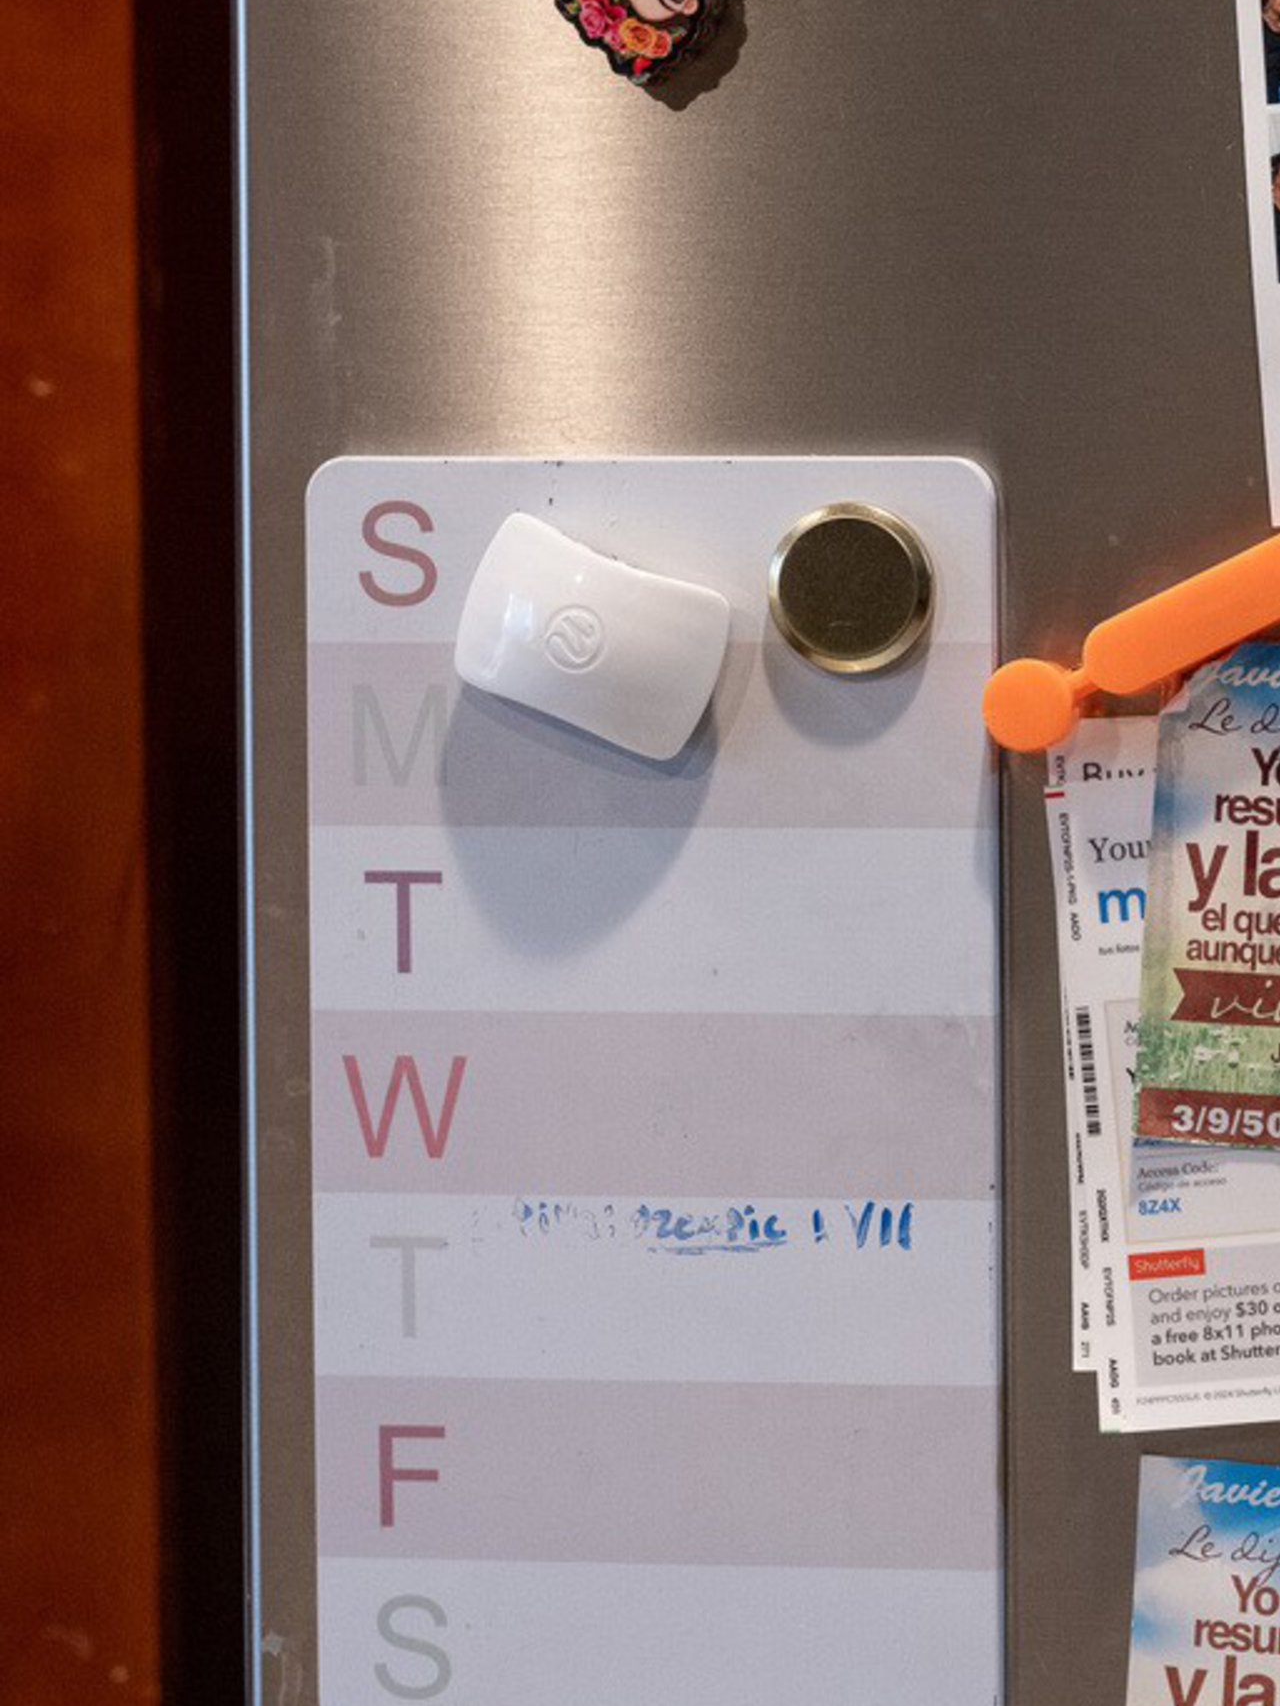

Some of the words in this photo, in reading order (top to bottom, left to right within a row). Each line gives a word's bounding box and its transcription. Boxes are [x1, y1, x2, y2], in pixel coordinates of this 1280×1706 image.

[359, 501, 439, 607] S
[351, 682, 449, 787] M
[363, 870, 443, 974] T
[342, 1055, 468, 1159] W
[1138, 1198, 1181, 1215] 8Z4X
[370, 1236, 446, 1339] T
[1135, 1254, 1200, 1274] Shutterfly
[1148, 1288, 1197, 1304] Order
[1203, 1284, 1270, 1302] pictures
[1151, 1309, 1181, 1324] and
[1185, 1306, 1231, 1325] enjoy
[1235, 1301, 1268, 1318] $30
[1153, 1349, 1196, 1366] book
[1201, 1348, 1217, 1362] at
[1165, 1328, 1198, 1343] free
[1203, 1324, 1244, 1341] 8x11
[378, 1424, 446, 1527] F
[373, 1595, 454, 1701] S
